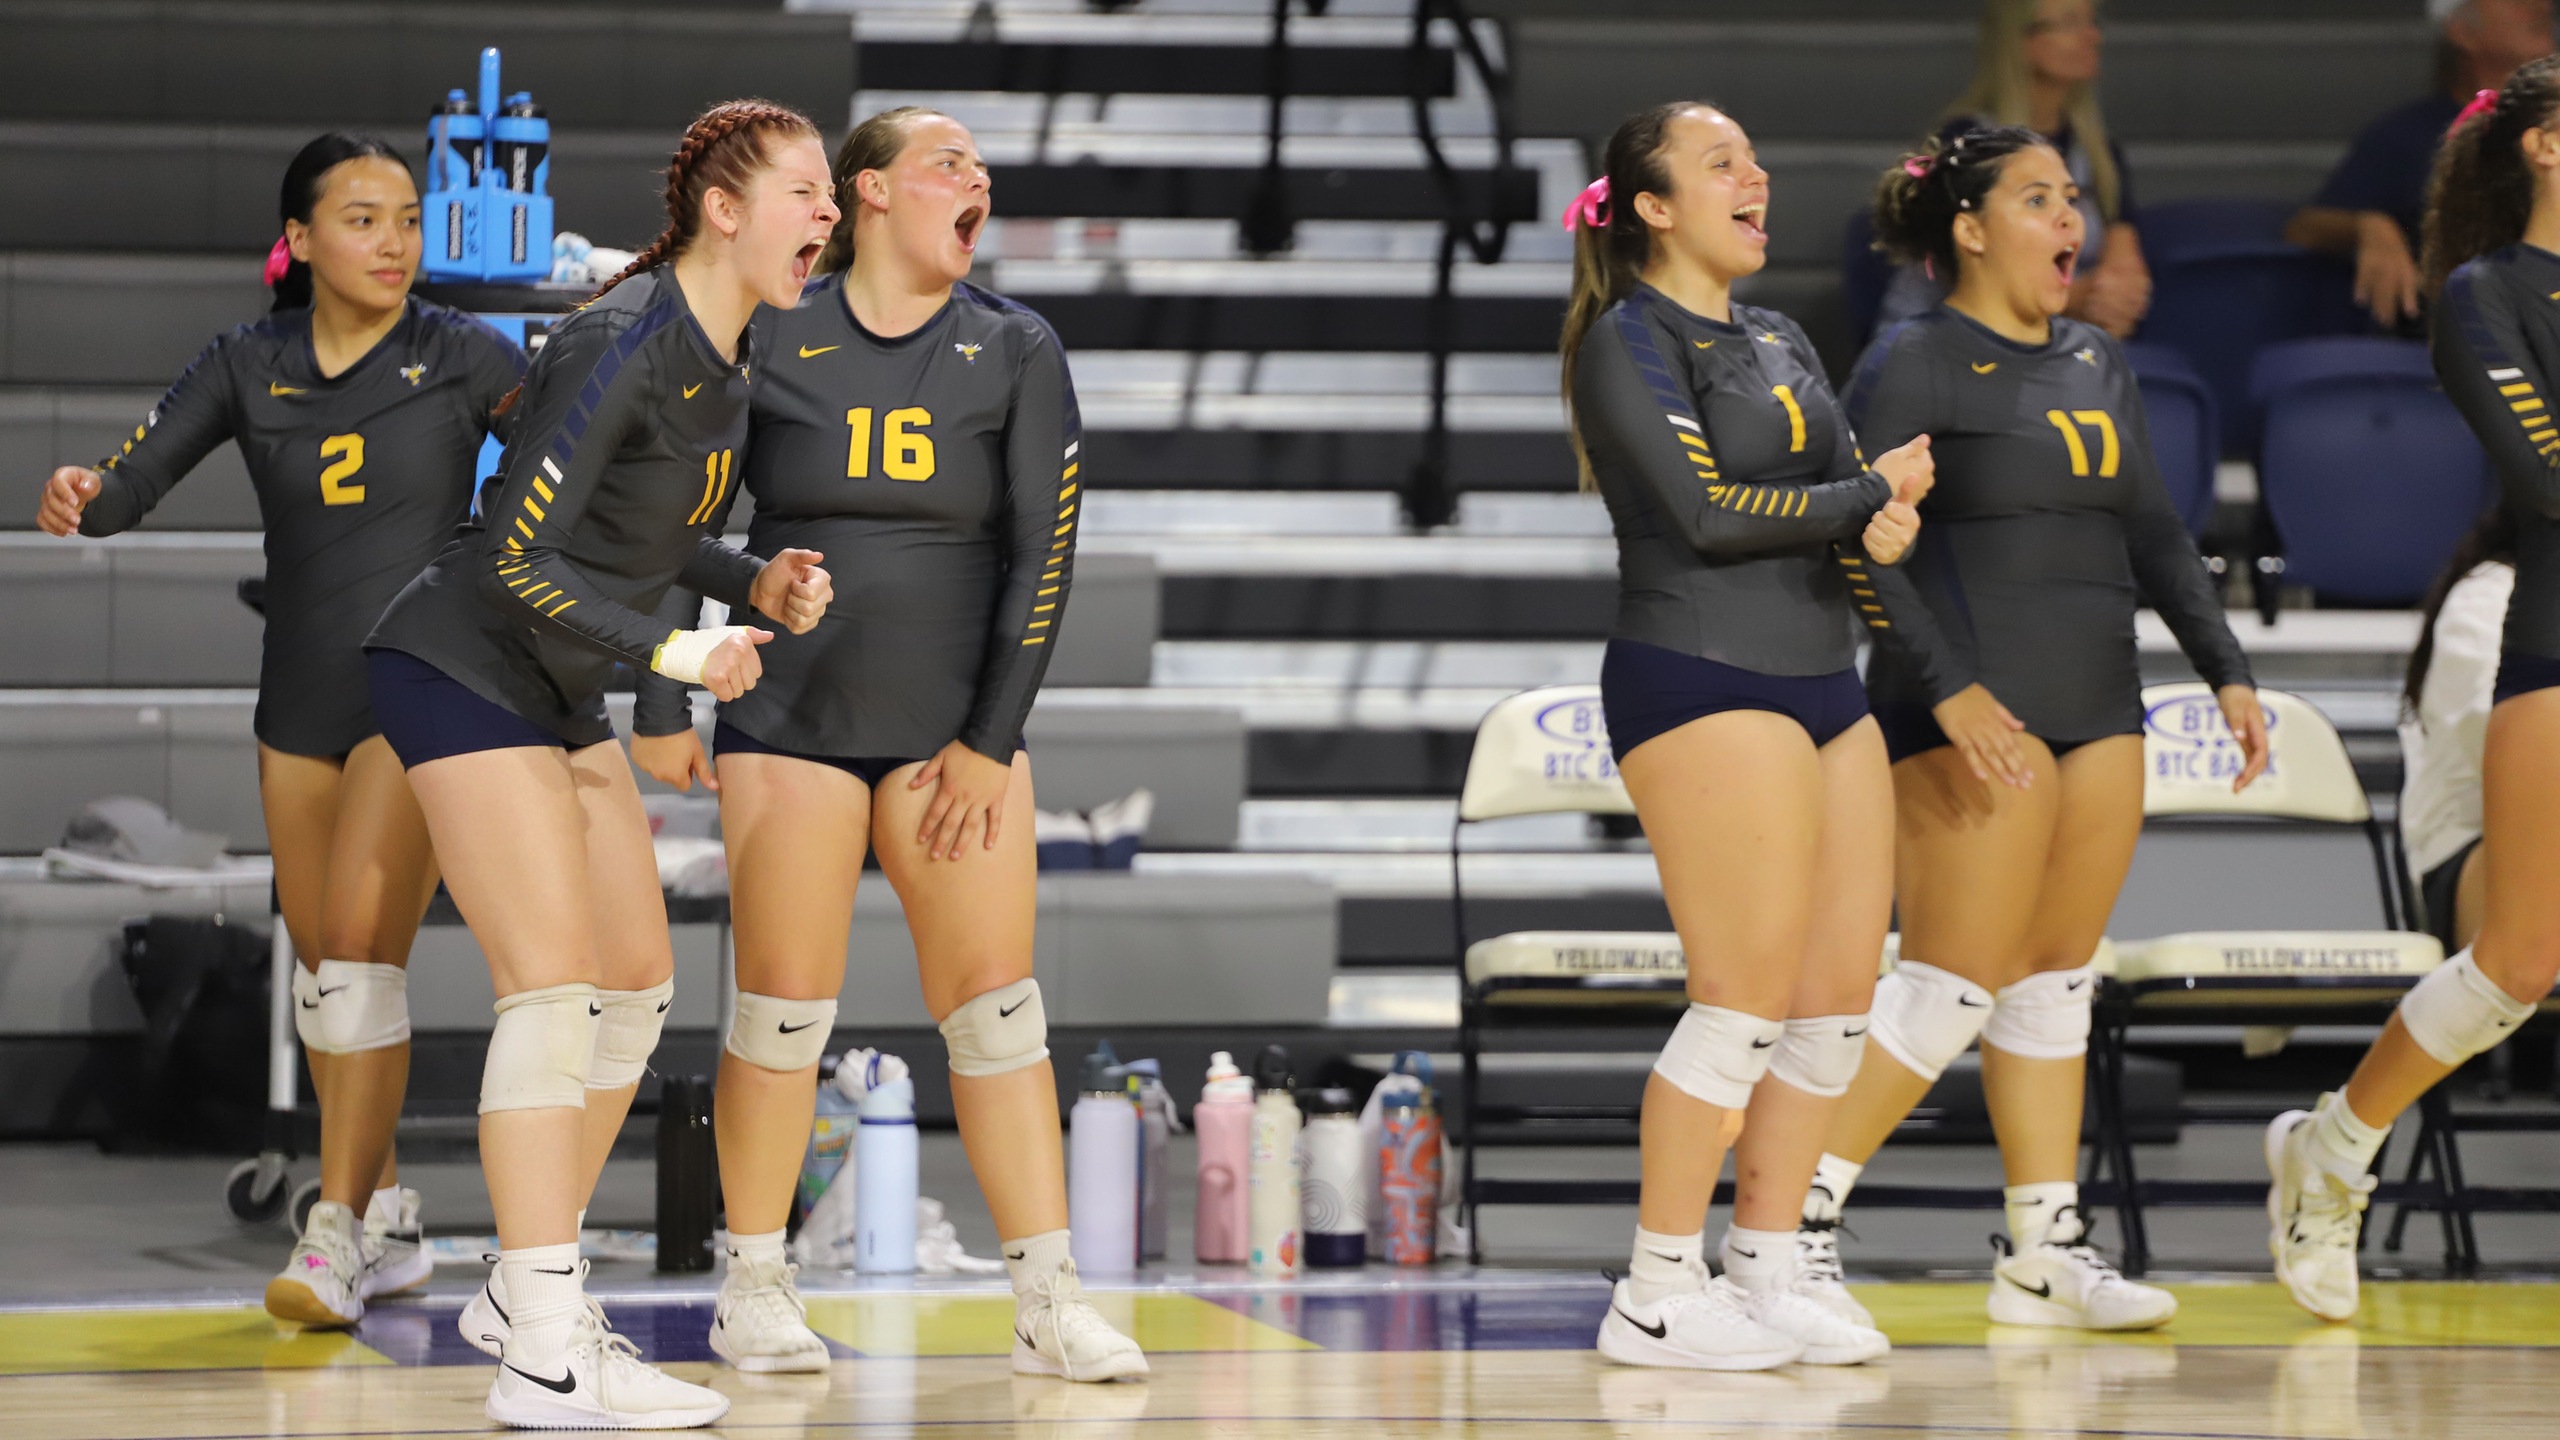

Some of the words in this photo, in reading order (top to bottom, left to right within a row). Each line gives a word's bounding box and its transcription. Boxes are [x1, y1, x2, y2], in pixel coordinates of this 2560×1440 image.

[1771, 384, 1807, 453] 1
[2045, 408, 2120, 478] 17
[846, 406, 936, 482] 16
[319, 432, 366, 506] 2
[686, 448, 732, 526] 11
[1572, 704, 1607, 733] BT
[1544, 752, 1588, 780] BTC
[2156, 751, 2200, 778] BTC
[2208, 751, 2278, 778] BAK
[1552, 947, 1687, 970] YELLOWJACK
[2221, 949, 2398, 969] YELLOWJACKETS
